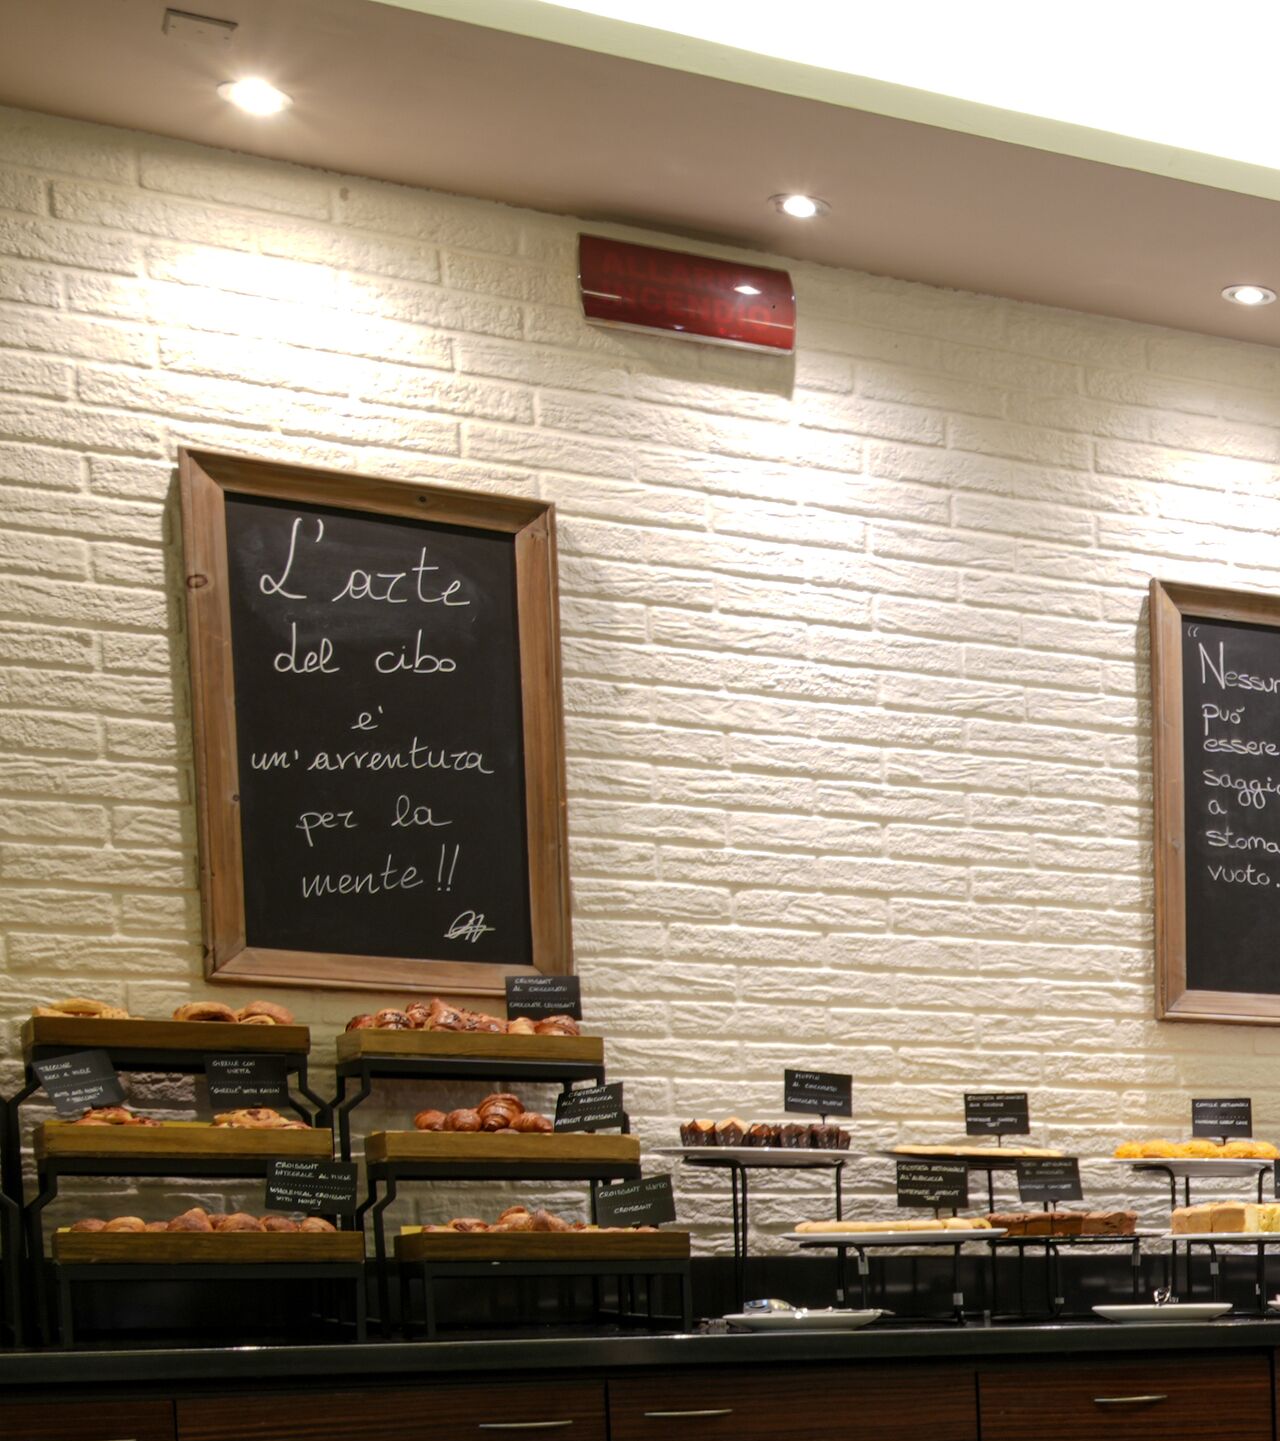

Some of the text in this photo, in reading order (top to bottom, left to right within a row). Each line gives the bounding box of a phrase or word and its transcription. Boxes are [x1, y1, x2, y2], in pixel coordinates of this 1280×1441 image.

[273, 622, 457, 673] del cibo
[1203, 737, 1280, 757] essere
[296, 794, 453, 847] per la
[1208, 799, 1228, 816] a
